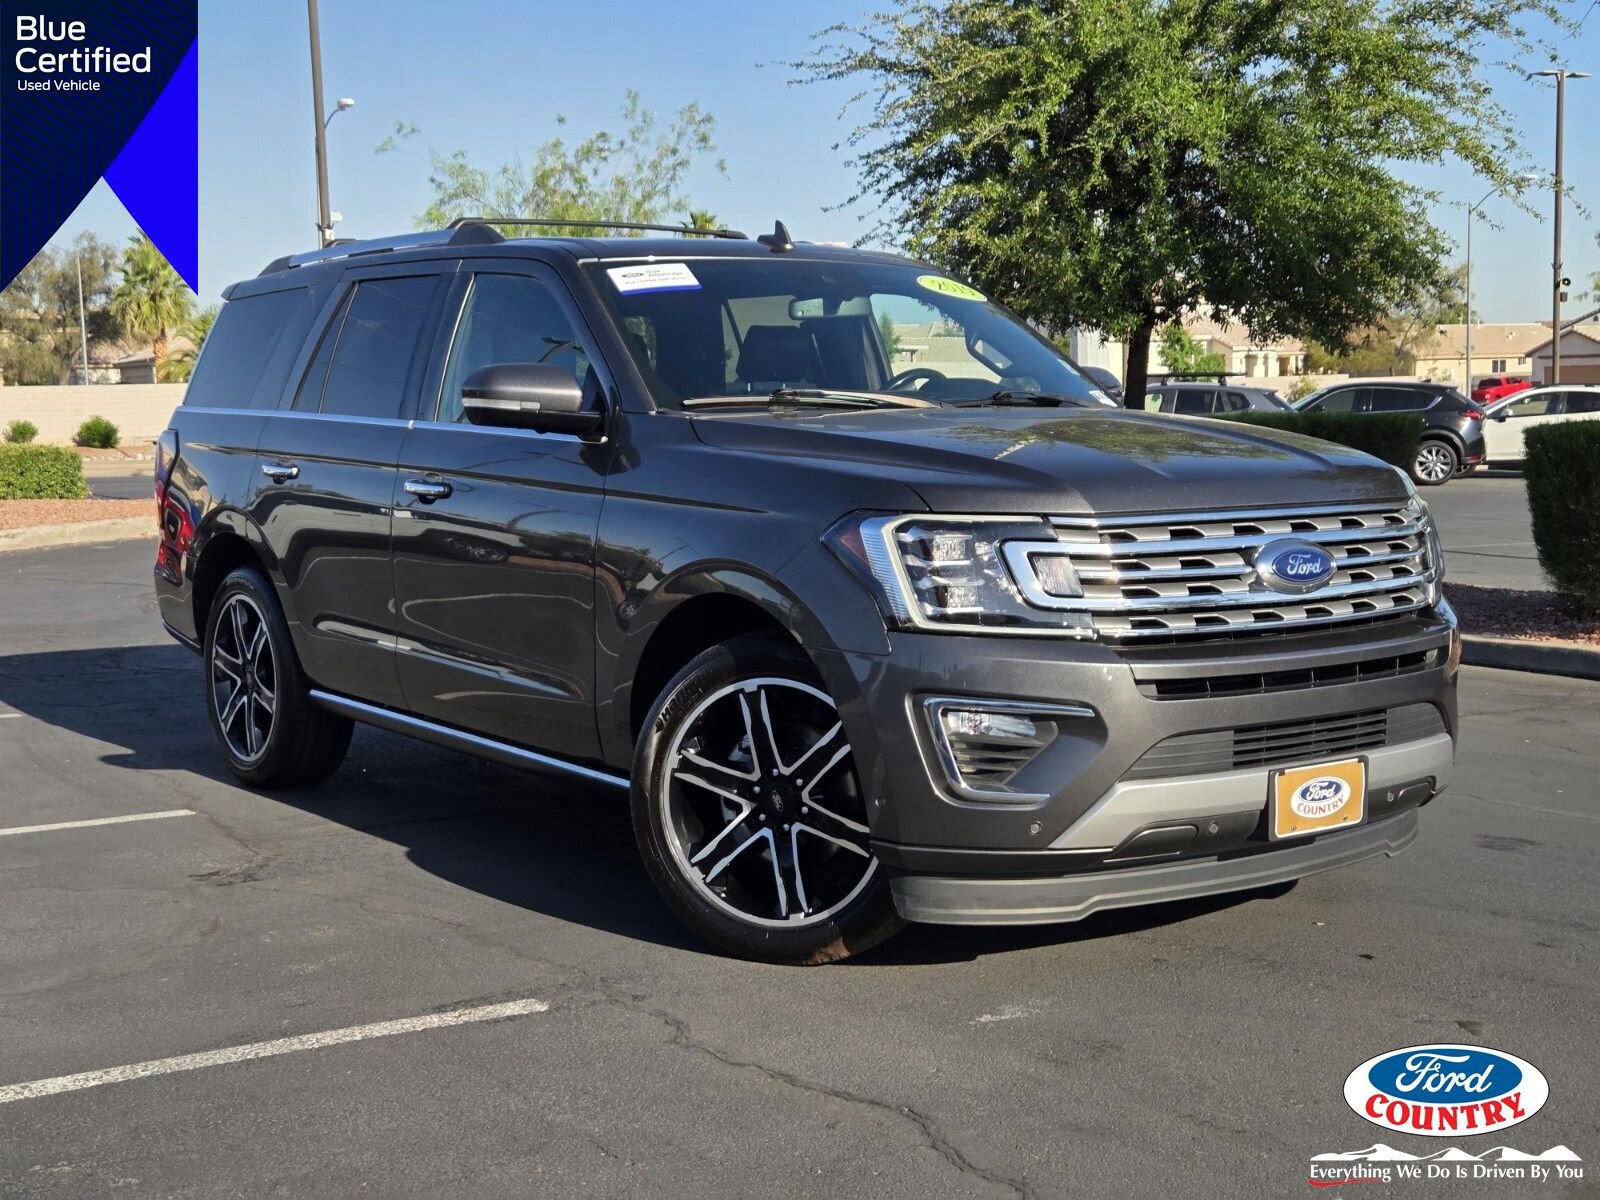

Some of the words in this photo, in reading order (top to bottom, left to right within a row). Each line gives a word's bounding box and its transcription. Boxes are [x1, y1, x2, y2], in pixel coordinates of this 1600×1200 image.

[1286, 553, 1323, 575] Ford
[1306, 781, 1337, 801] Ford
[1296, 794, 1344, 816] COUNTRY
